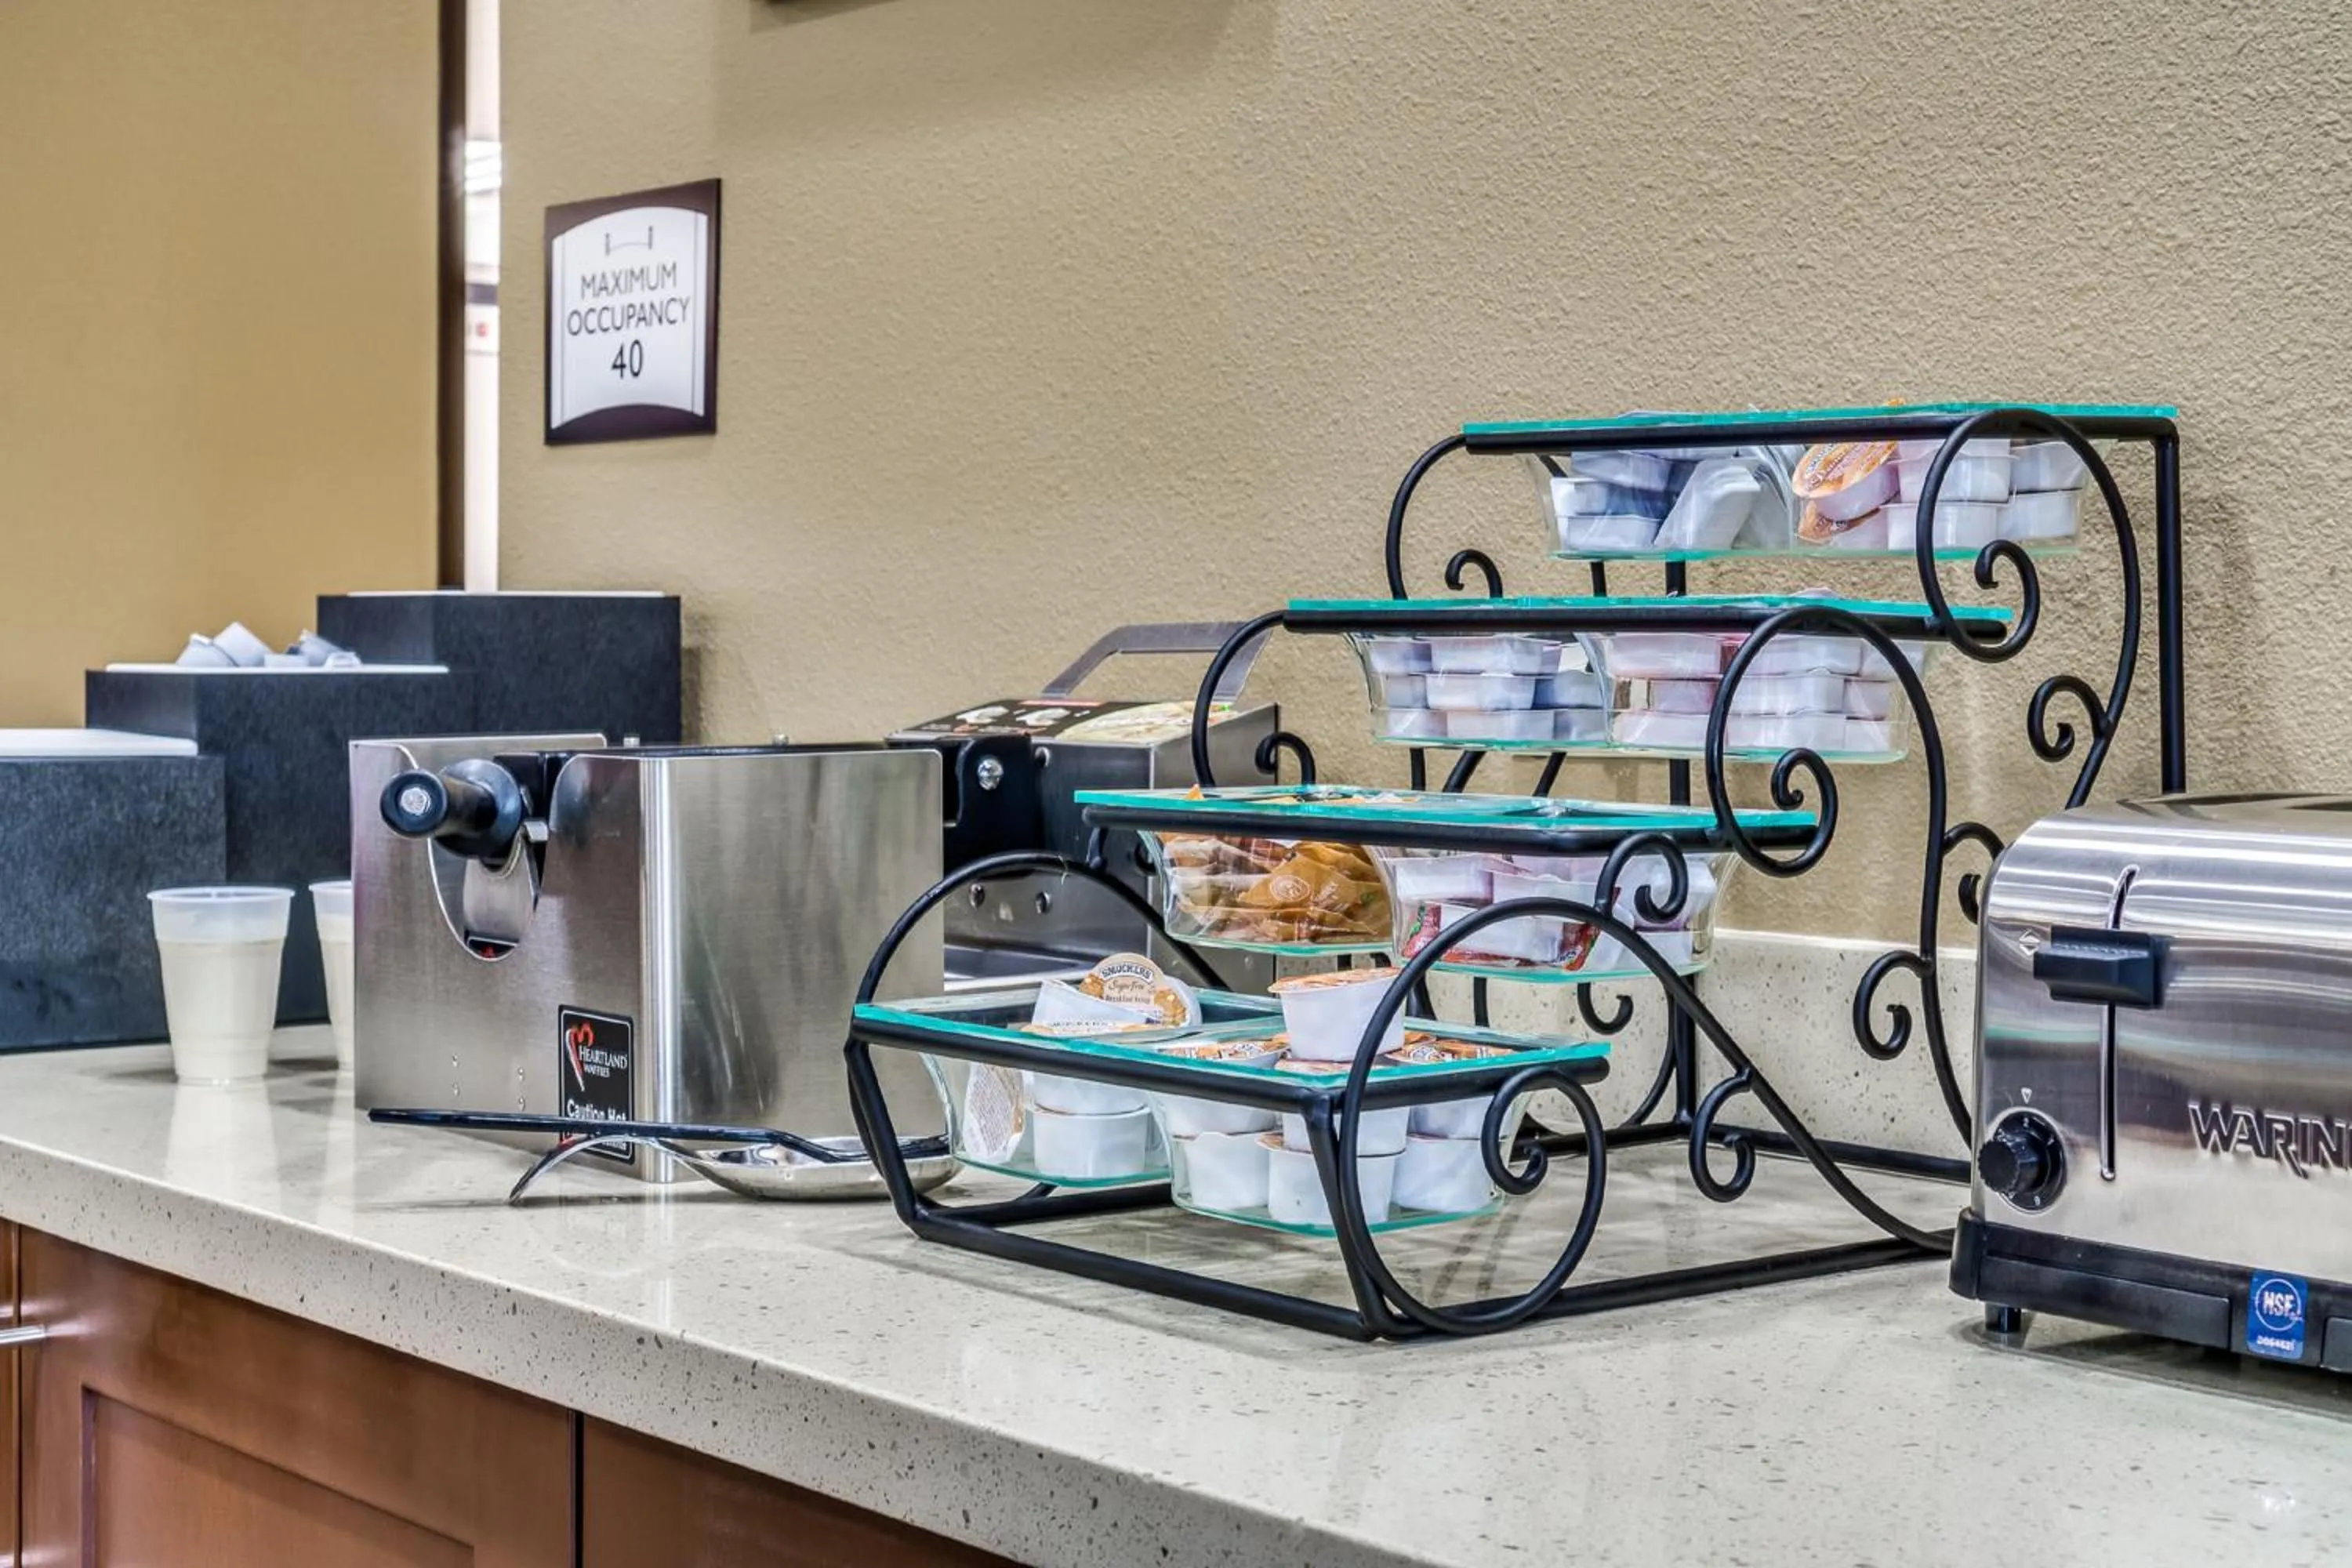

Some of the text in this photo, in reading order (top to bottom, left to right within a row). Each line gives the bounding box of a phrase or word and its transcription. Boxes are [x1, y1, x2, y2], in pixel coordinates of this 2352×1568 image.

[580, 261, 677, 299] MAXIMUM
[567, 297, 690, 336] OCCUPANCY
[612, 339, 643, 379] 40
[579, 1044, 628, 1069] HEARTLAND
[567, 1098, 605, 1121] Caution
[2187, 1102, 2352, 1179] WARIN
[2263, 1290, 2296, 1317] NSF
